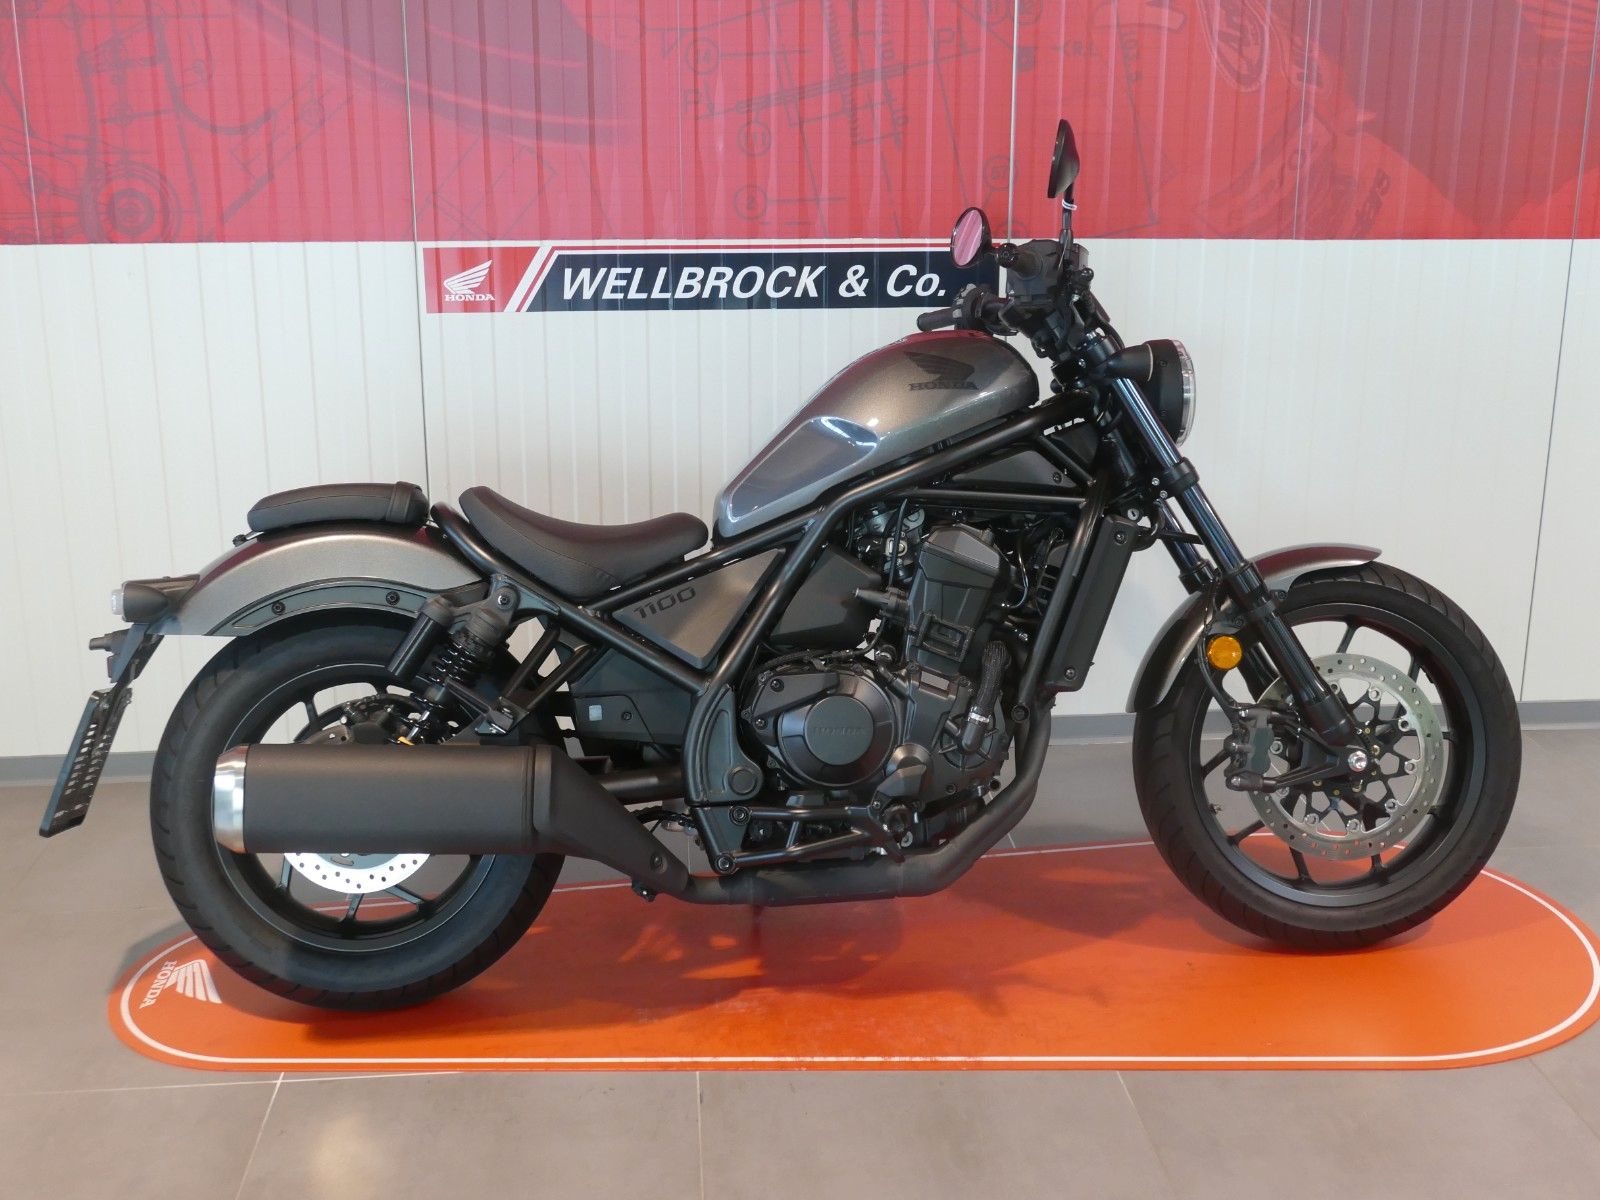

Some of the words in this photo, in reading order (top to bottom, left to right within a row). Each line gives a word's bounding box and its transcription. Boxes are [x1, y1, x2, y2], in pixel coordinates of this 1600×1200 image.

[444, 294, 496, 302] HONDA
[563, 265, 828, 300] WELLBROCK
[838, 264, 870, 298] &
[886, 264, 947, 297] Co.
[633, 586, 696, 619] 1100
[139, 960, 178, 1010] HONDA
